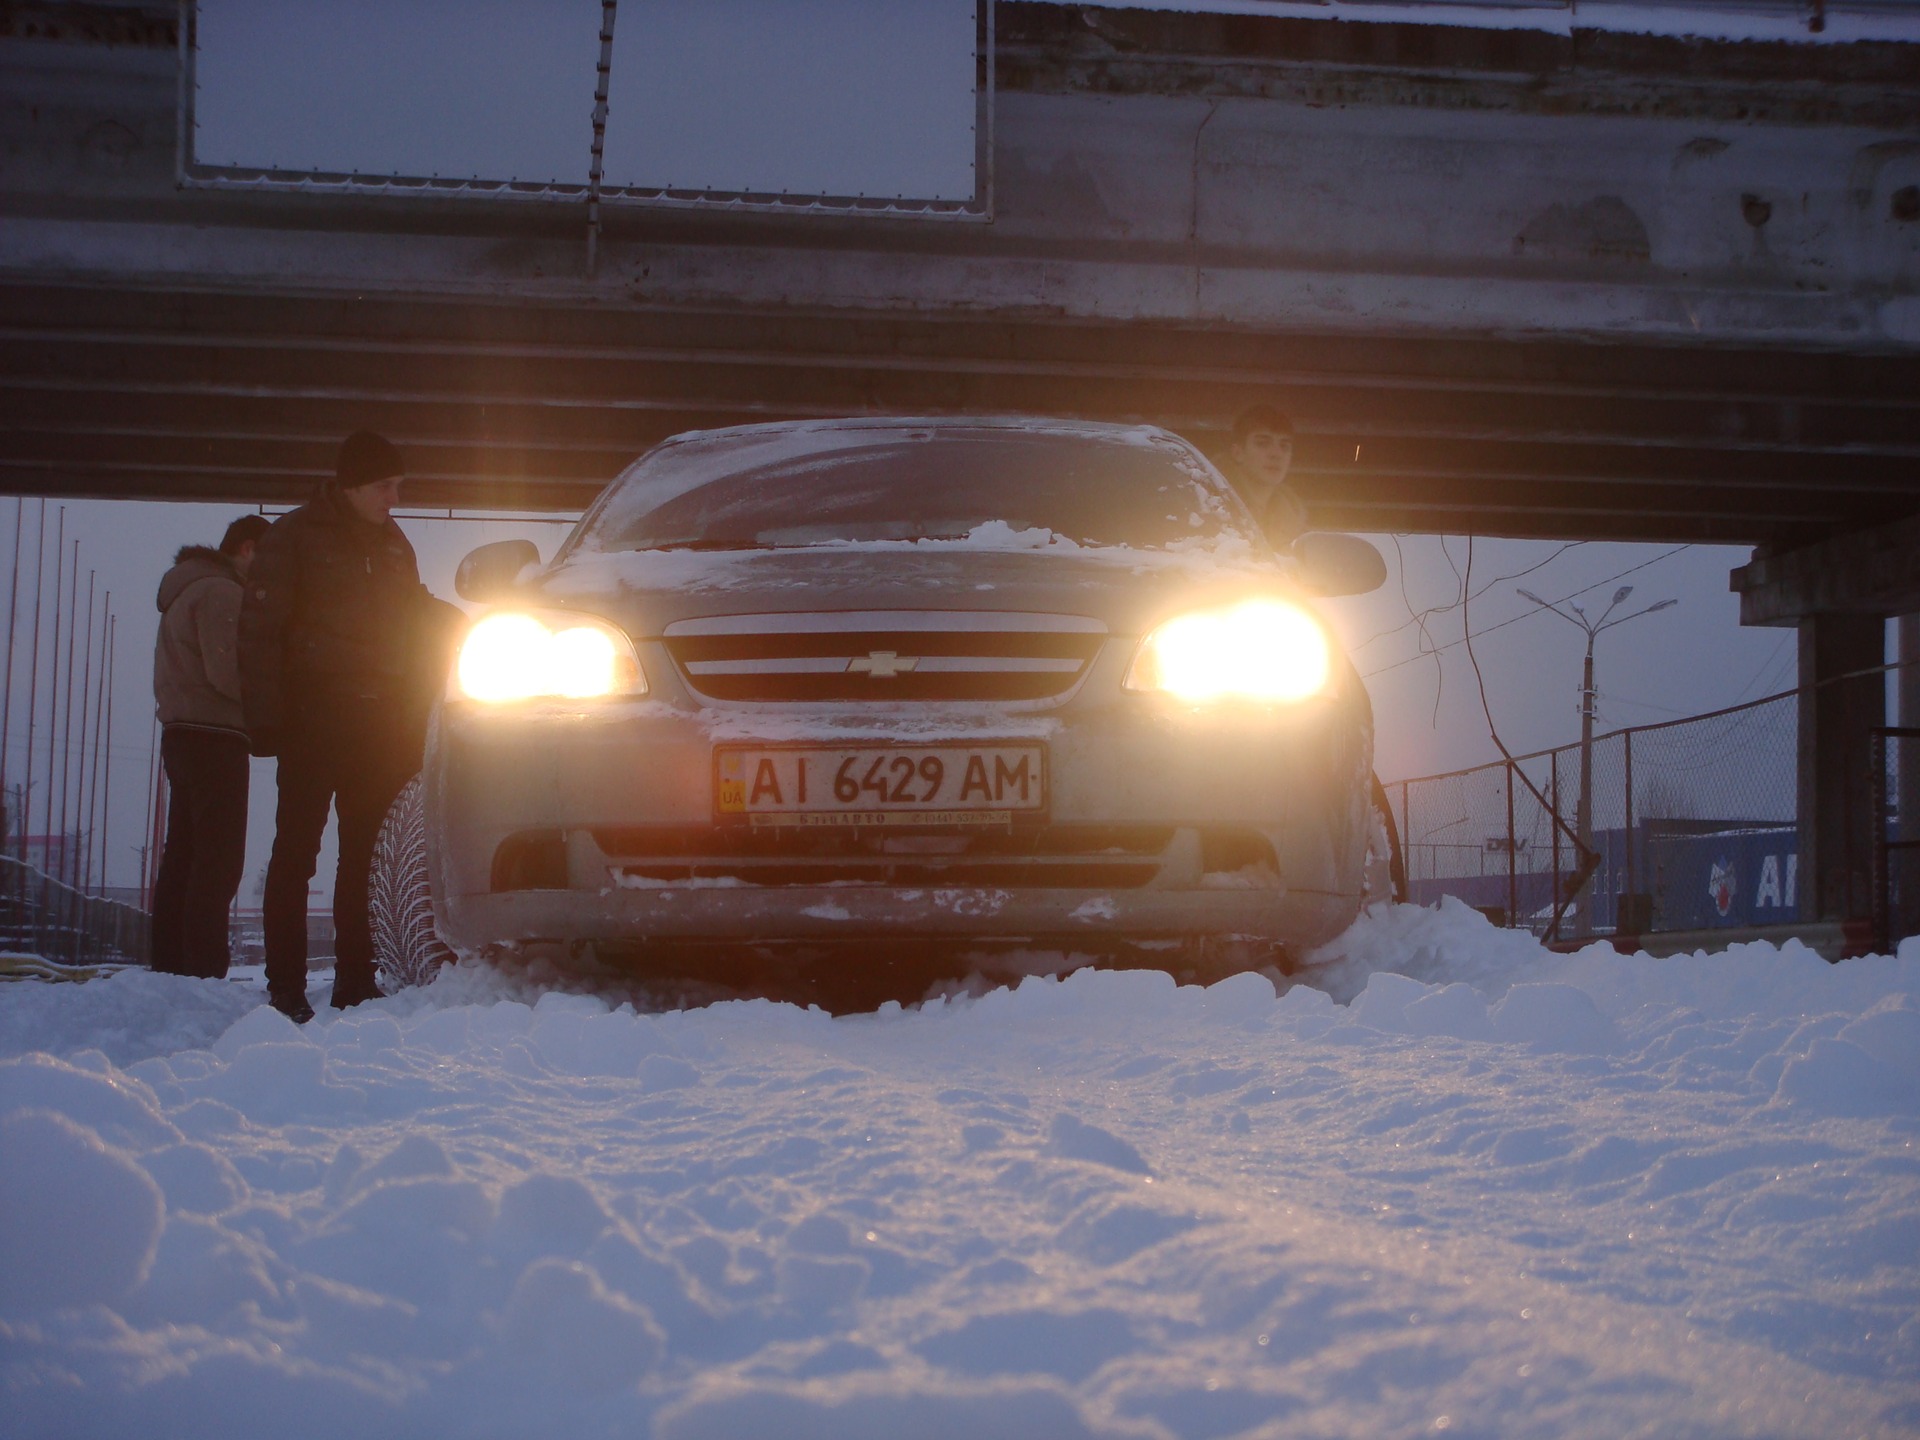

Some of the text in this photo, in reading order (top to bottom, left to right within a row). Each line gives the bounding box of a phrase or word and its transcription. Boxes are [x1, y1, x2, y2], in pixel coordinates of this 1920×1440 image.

[750, 754, 1029, 804] AI 6429 AM
[722, 791, 743, 804] UA
